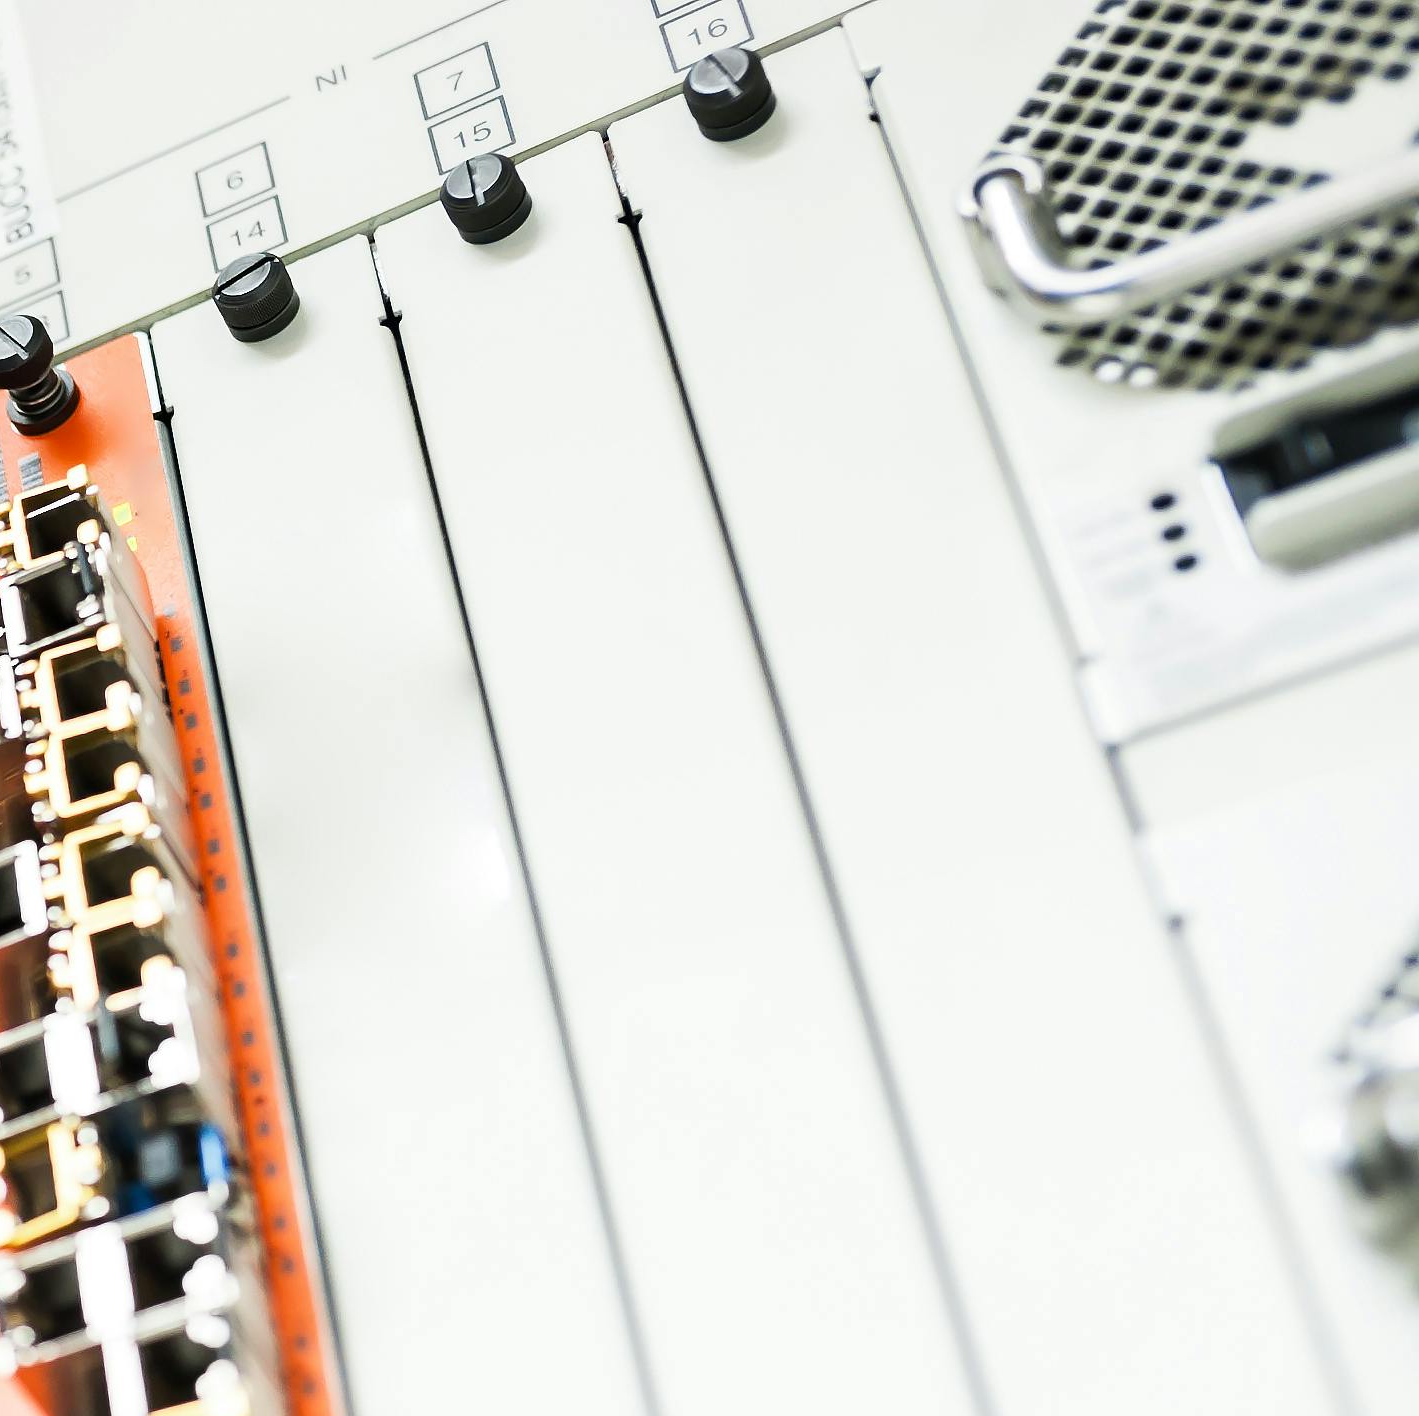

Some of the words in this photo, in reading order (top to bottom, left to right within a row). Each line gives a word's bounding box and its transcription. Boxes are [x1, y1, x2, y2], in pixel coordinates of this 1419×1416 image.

[687, 18, 728, 45] 16
[315, 64, 347, 92] NI
[446, 70, 464, 92] 7
[453, 120, 492, 148] 15
[227, 170, 244, 190] 6
[230, 220, 266, 247] 14
